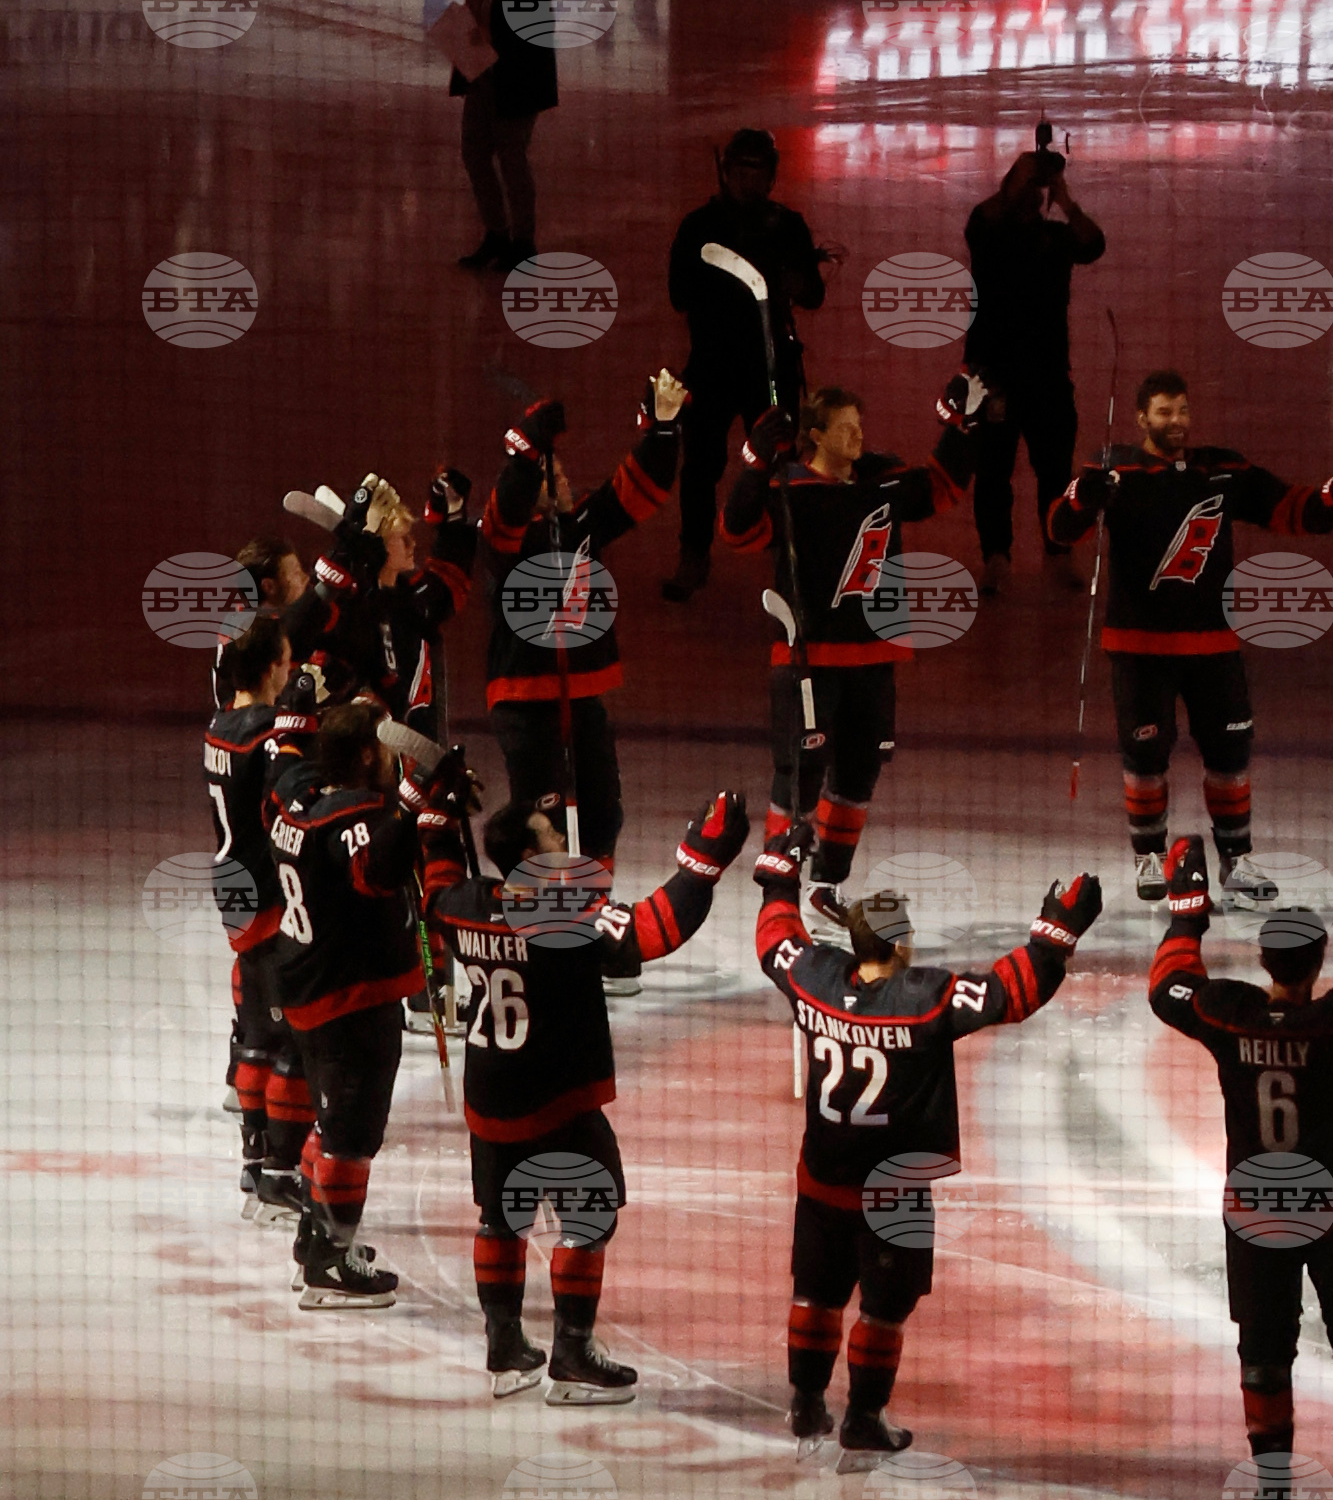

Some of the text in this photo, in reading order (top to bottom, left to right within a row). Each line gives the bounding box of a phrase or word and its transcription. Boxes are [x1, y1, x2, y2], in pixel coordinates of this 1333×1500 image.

[340, 821, 372, 859] 28
[595, 904, 632, 942] 26
[457, 928, 529, 963] WALKER
[468, 966, 531, 1051] 26
[953, 980, 988, 1014] 22
[797, 999, 913, 1050] STANKOVEN
[1239, 1036, 1310, 1068] REILLY
[814, 1036, 889, 1126] 22
[1256, 1070, 1300, 1153] 6
